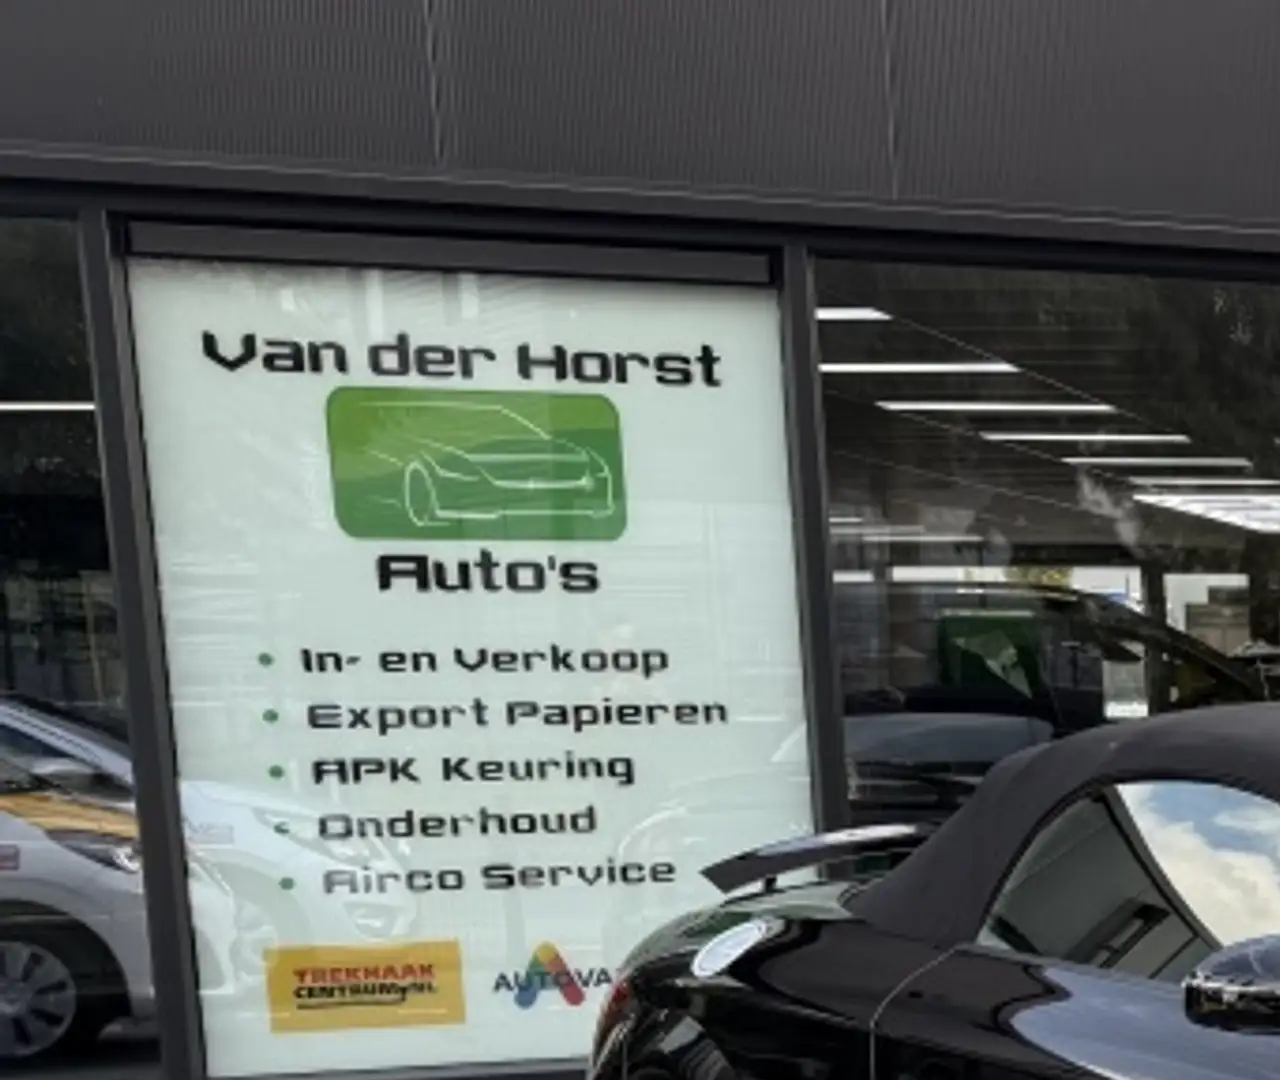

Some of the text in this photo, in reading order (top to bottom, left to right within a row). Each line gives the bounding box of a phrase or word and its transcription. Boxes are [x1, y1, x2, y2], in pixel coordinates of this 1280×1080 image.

[201, 330, 721, 387] Van der Horst
[376, 549, 600, 593] Auto's
[300, 644, 670, 679] In- en Verkoop
[306, 698, 729, 736] Export Papieren
[312, 750, 636, 785] APK Keuring
[318, 805, 598, 839] Onderhoud
[322, 856, 678, 896] Airco Service
